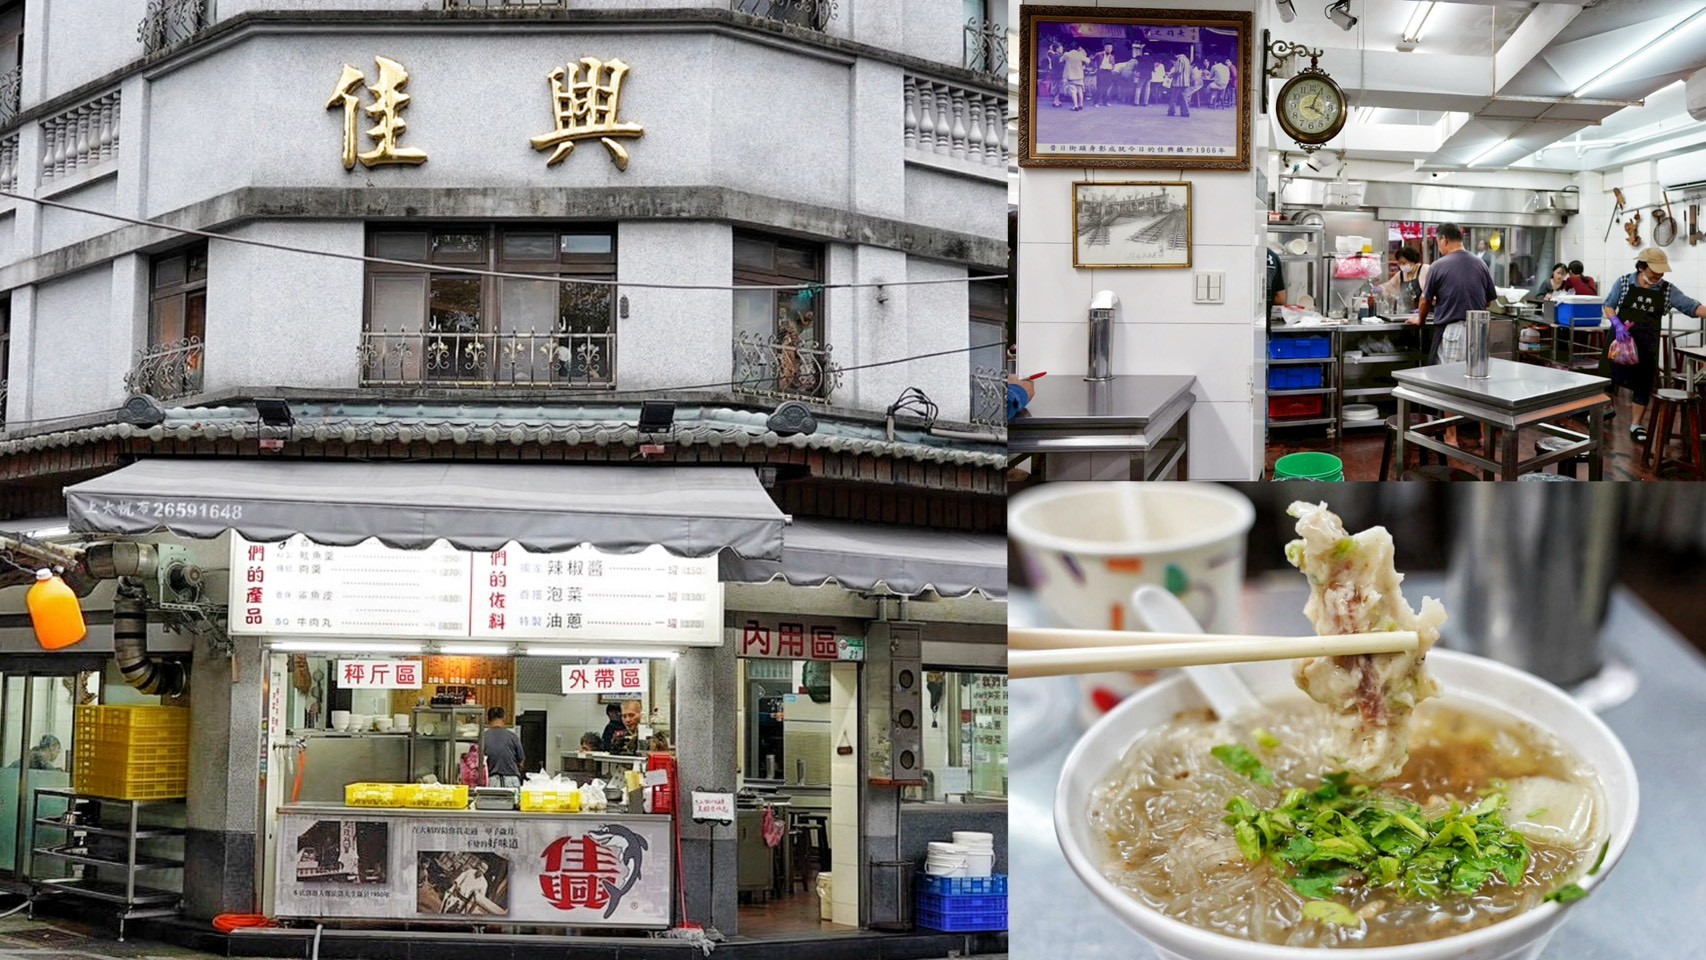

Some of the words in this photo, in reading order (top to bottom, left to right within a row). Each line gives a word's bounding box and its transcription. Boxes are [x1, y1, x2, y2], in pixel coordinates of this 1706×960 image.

[547, 586, 583, 603] 泡菜
[743, 619, 839, 659] 內用區
[344, 663, 416, 684] 秤斤區
[569, 668, 641, 689] 外帶區
